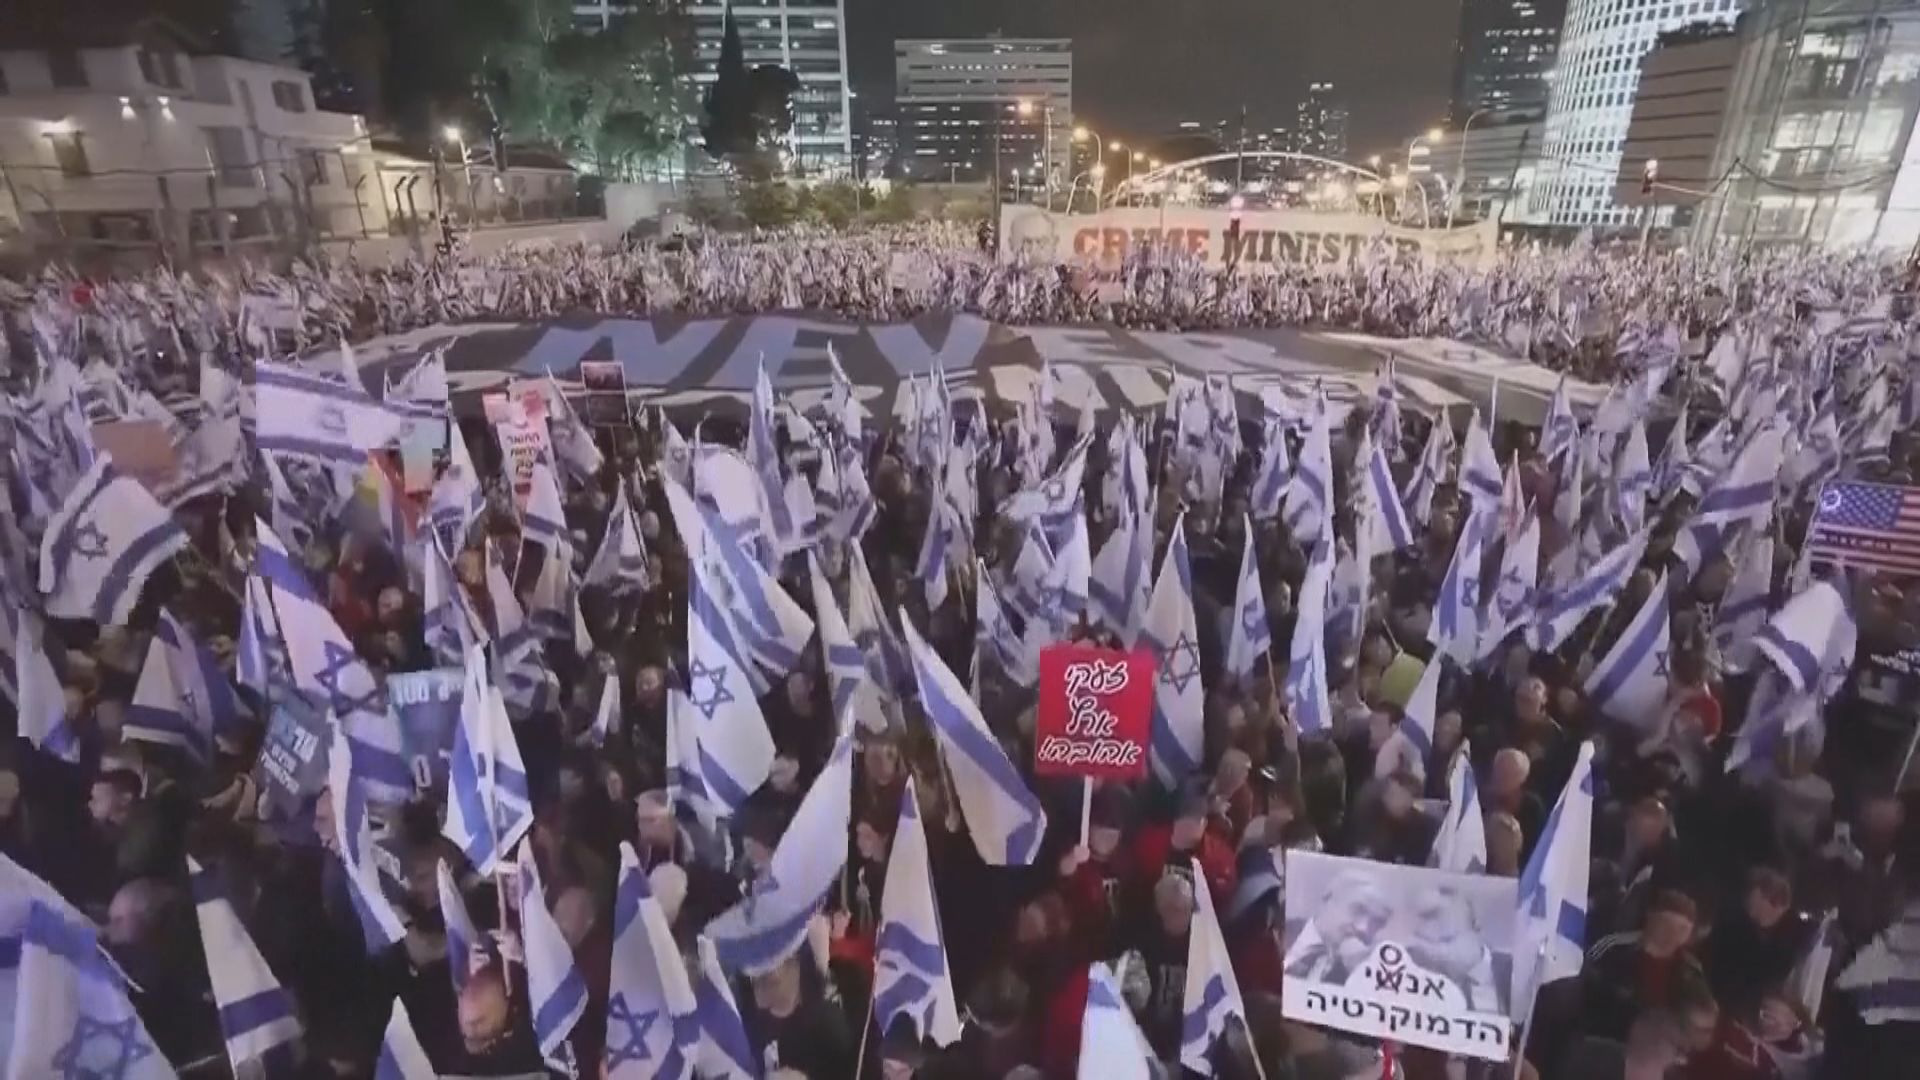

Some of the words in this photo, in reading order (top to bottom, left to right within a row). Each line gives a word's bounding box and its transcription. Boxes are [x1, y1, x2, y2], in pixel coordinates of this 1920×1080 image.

[1073, 226, 1210, 262] CRIME
[1066, 696, 1118, 735] ארץ
[1038, 735, 1142, 765] אהובה!
[1307, 990, 1503, 1045] הדמוקרטיה
